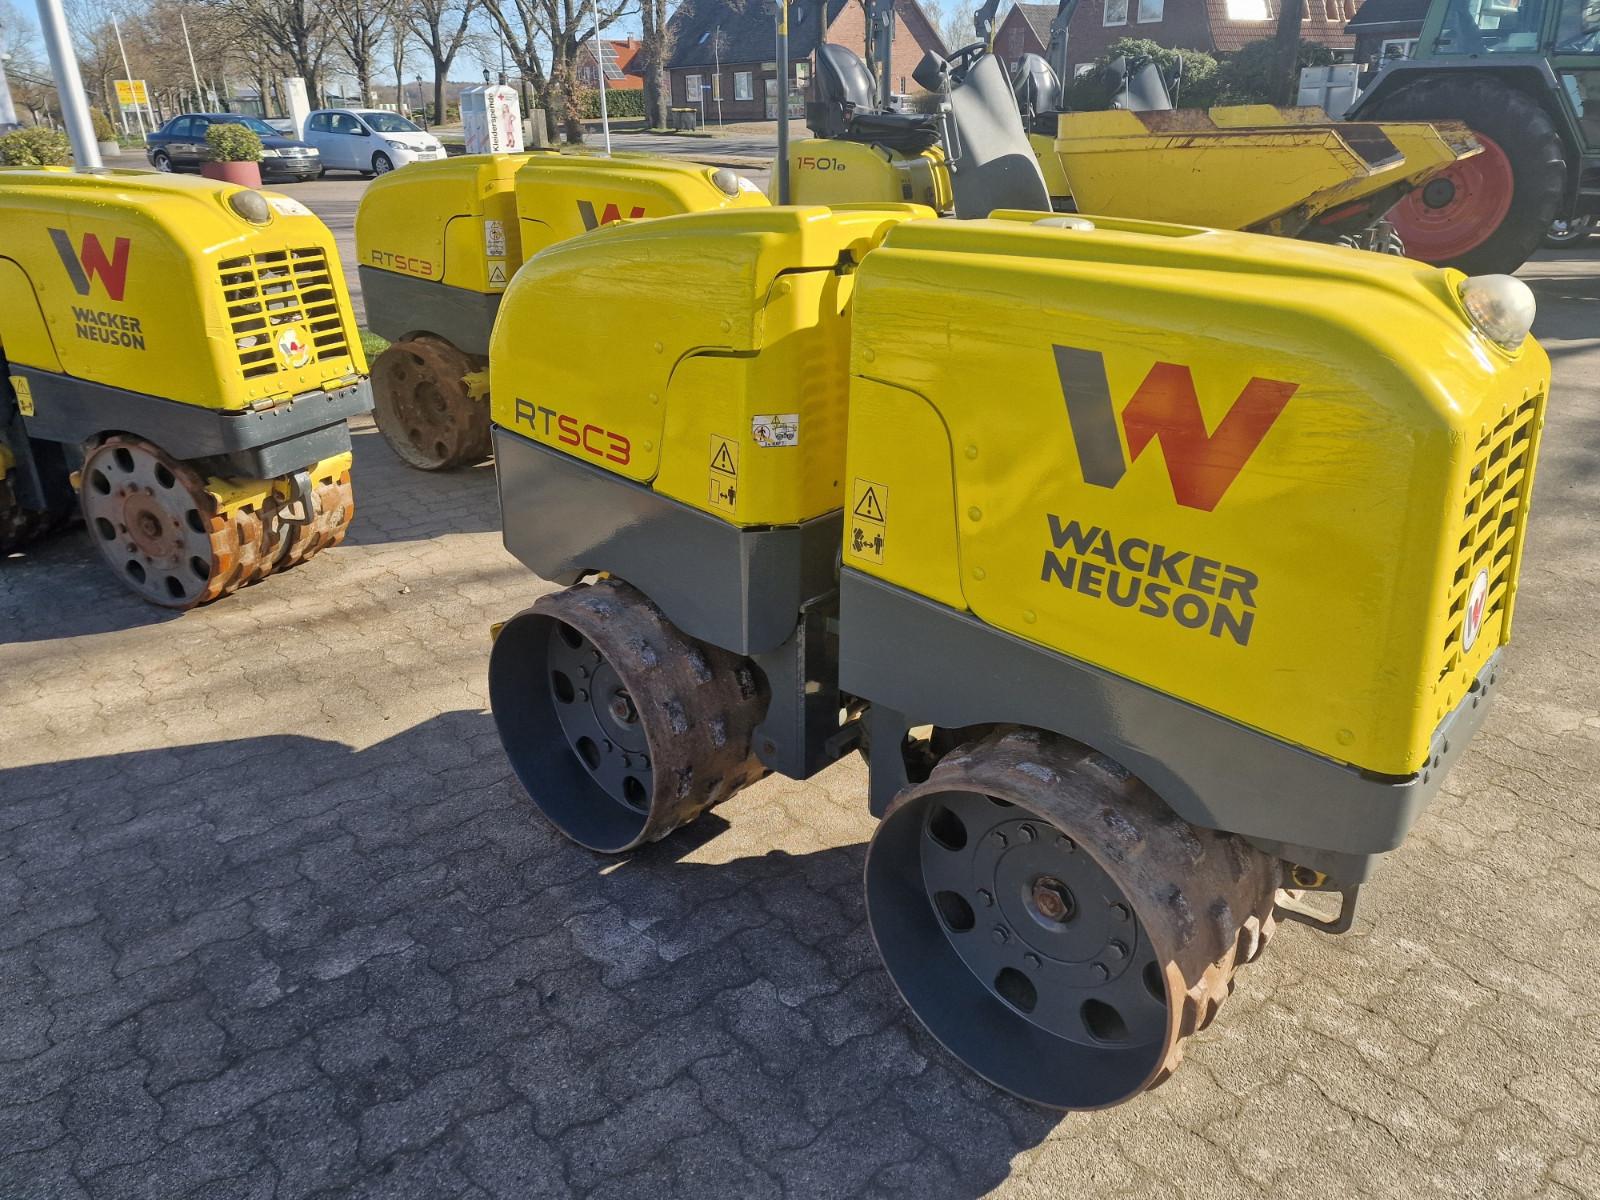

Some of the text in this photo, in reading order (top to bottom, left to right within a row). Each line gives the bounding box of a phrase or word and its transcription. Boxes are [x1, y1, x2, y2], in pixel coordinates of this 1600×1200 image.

[488, 93, 499, 151] Kleiderspende
[371, 249, 433, 276] RTSC3
[71, 305, 143, 334] WACKER
[75, 323, 146, 351] NEUSON
[515, 397, 631, 466] RTSC3
[1046, 513, 1259, 609] WACKER
[1040, 550, 1255, 647] NEUSON
